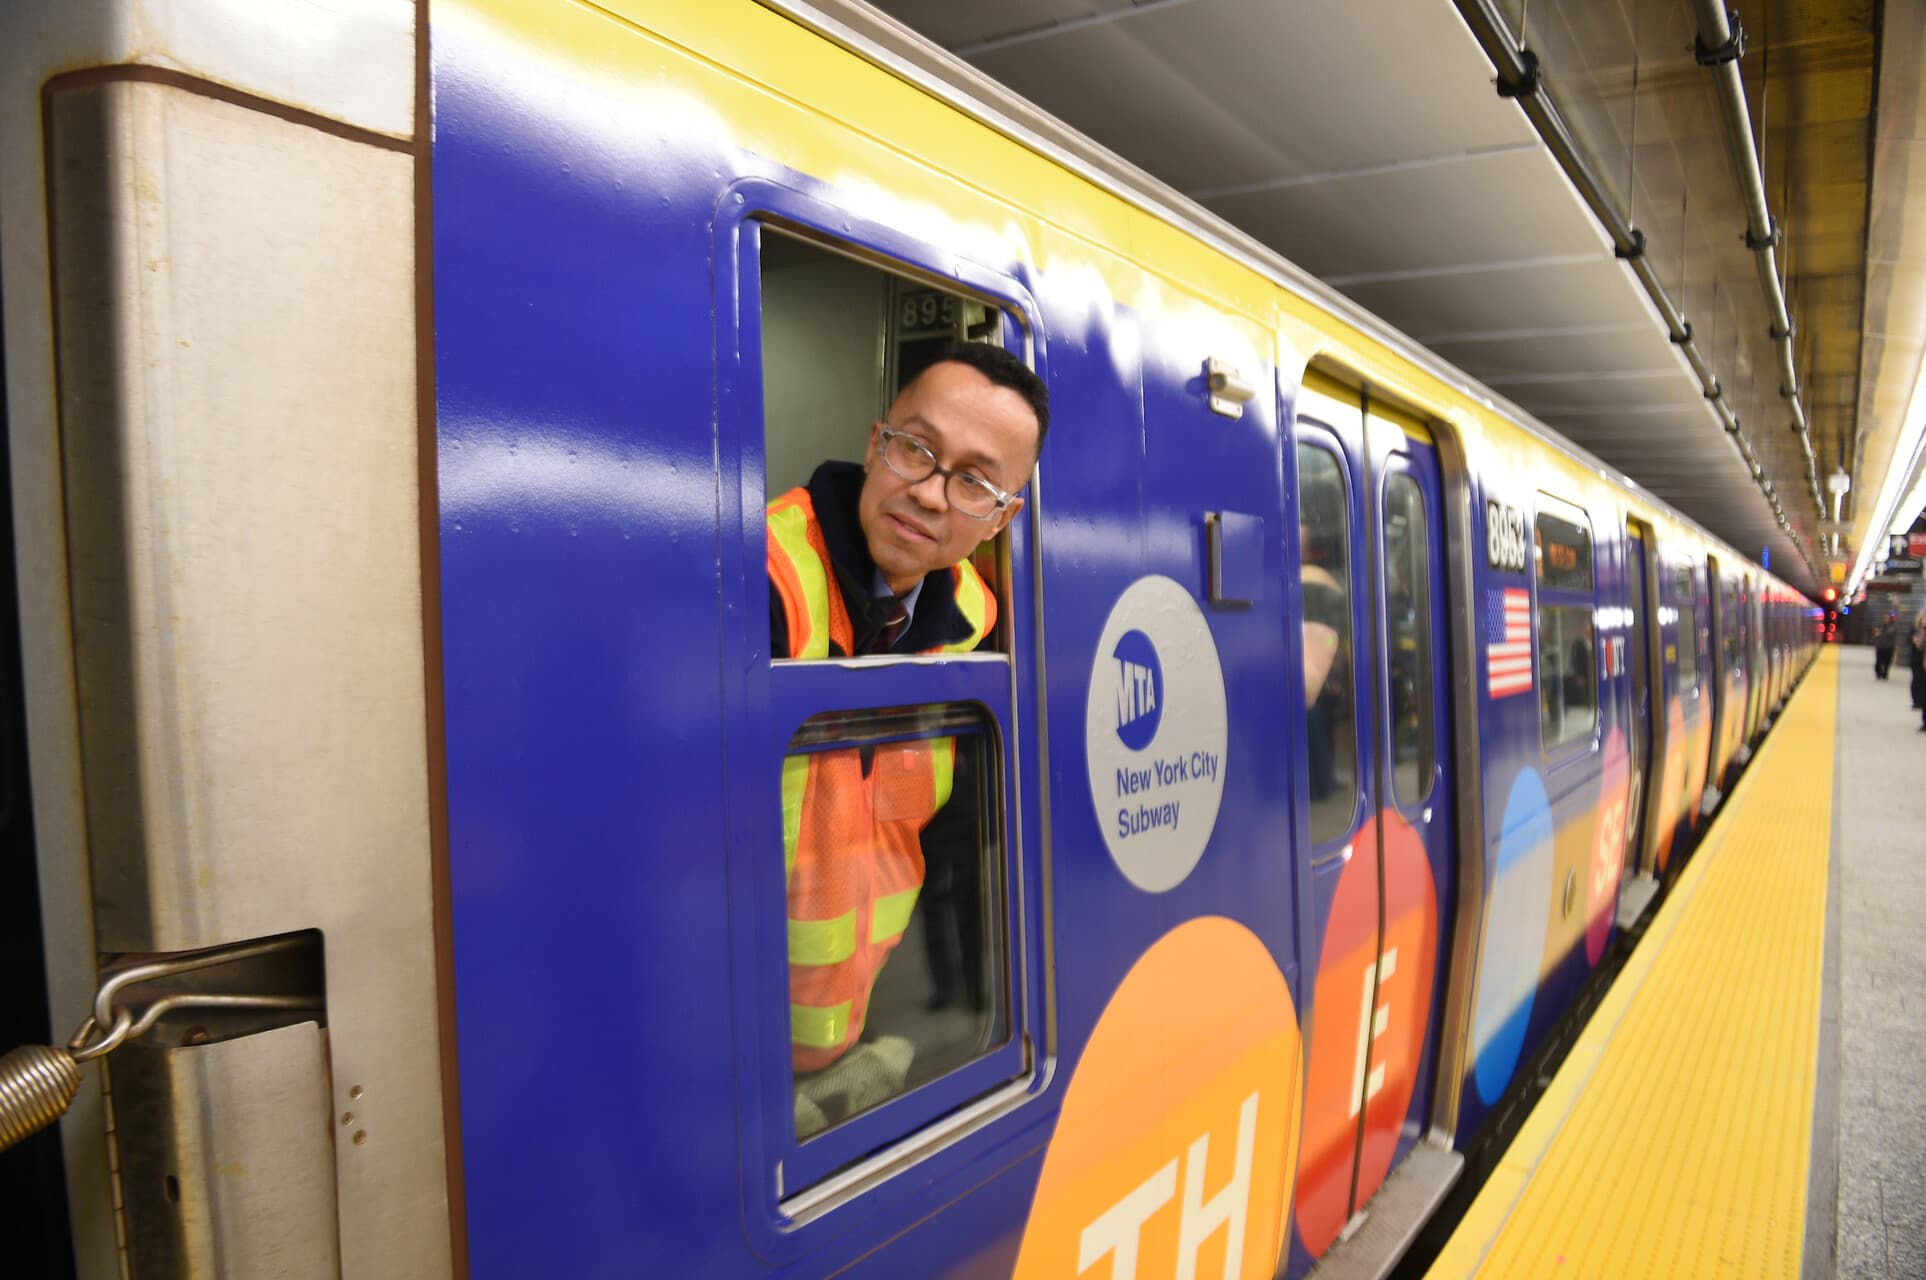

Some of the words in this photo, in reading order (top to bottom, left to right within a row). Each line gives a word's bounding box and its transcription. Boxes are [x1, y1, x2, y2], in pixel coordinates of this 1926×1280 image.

[1113, 656, 1156, 729] MTA
[1117, 766, 1151, 798] New
[1155, 756, 1188, 787] York
[1191, 751, 1218, 784] City
[1118, 801, 1180, 840] Subway
